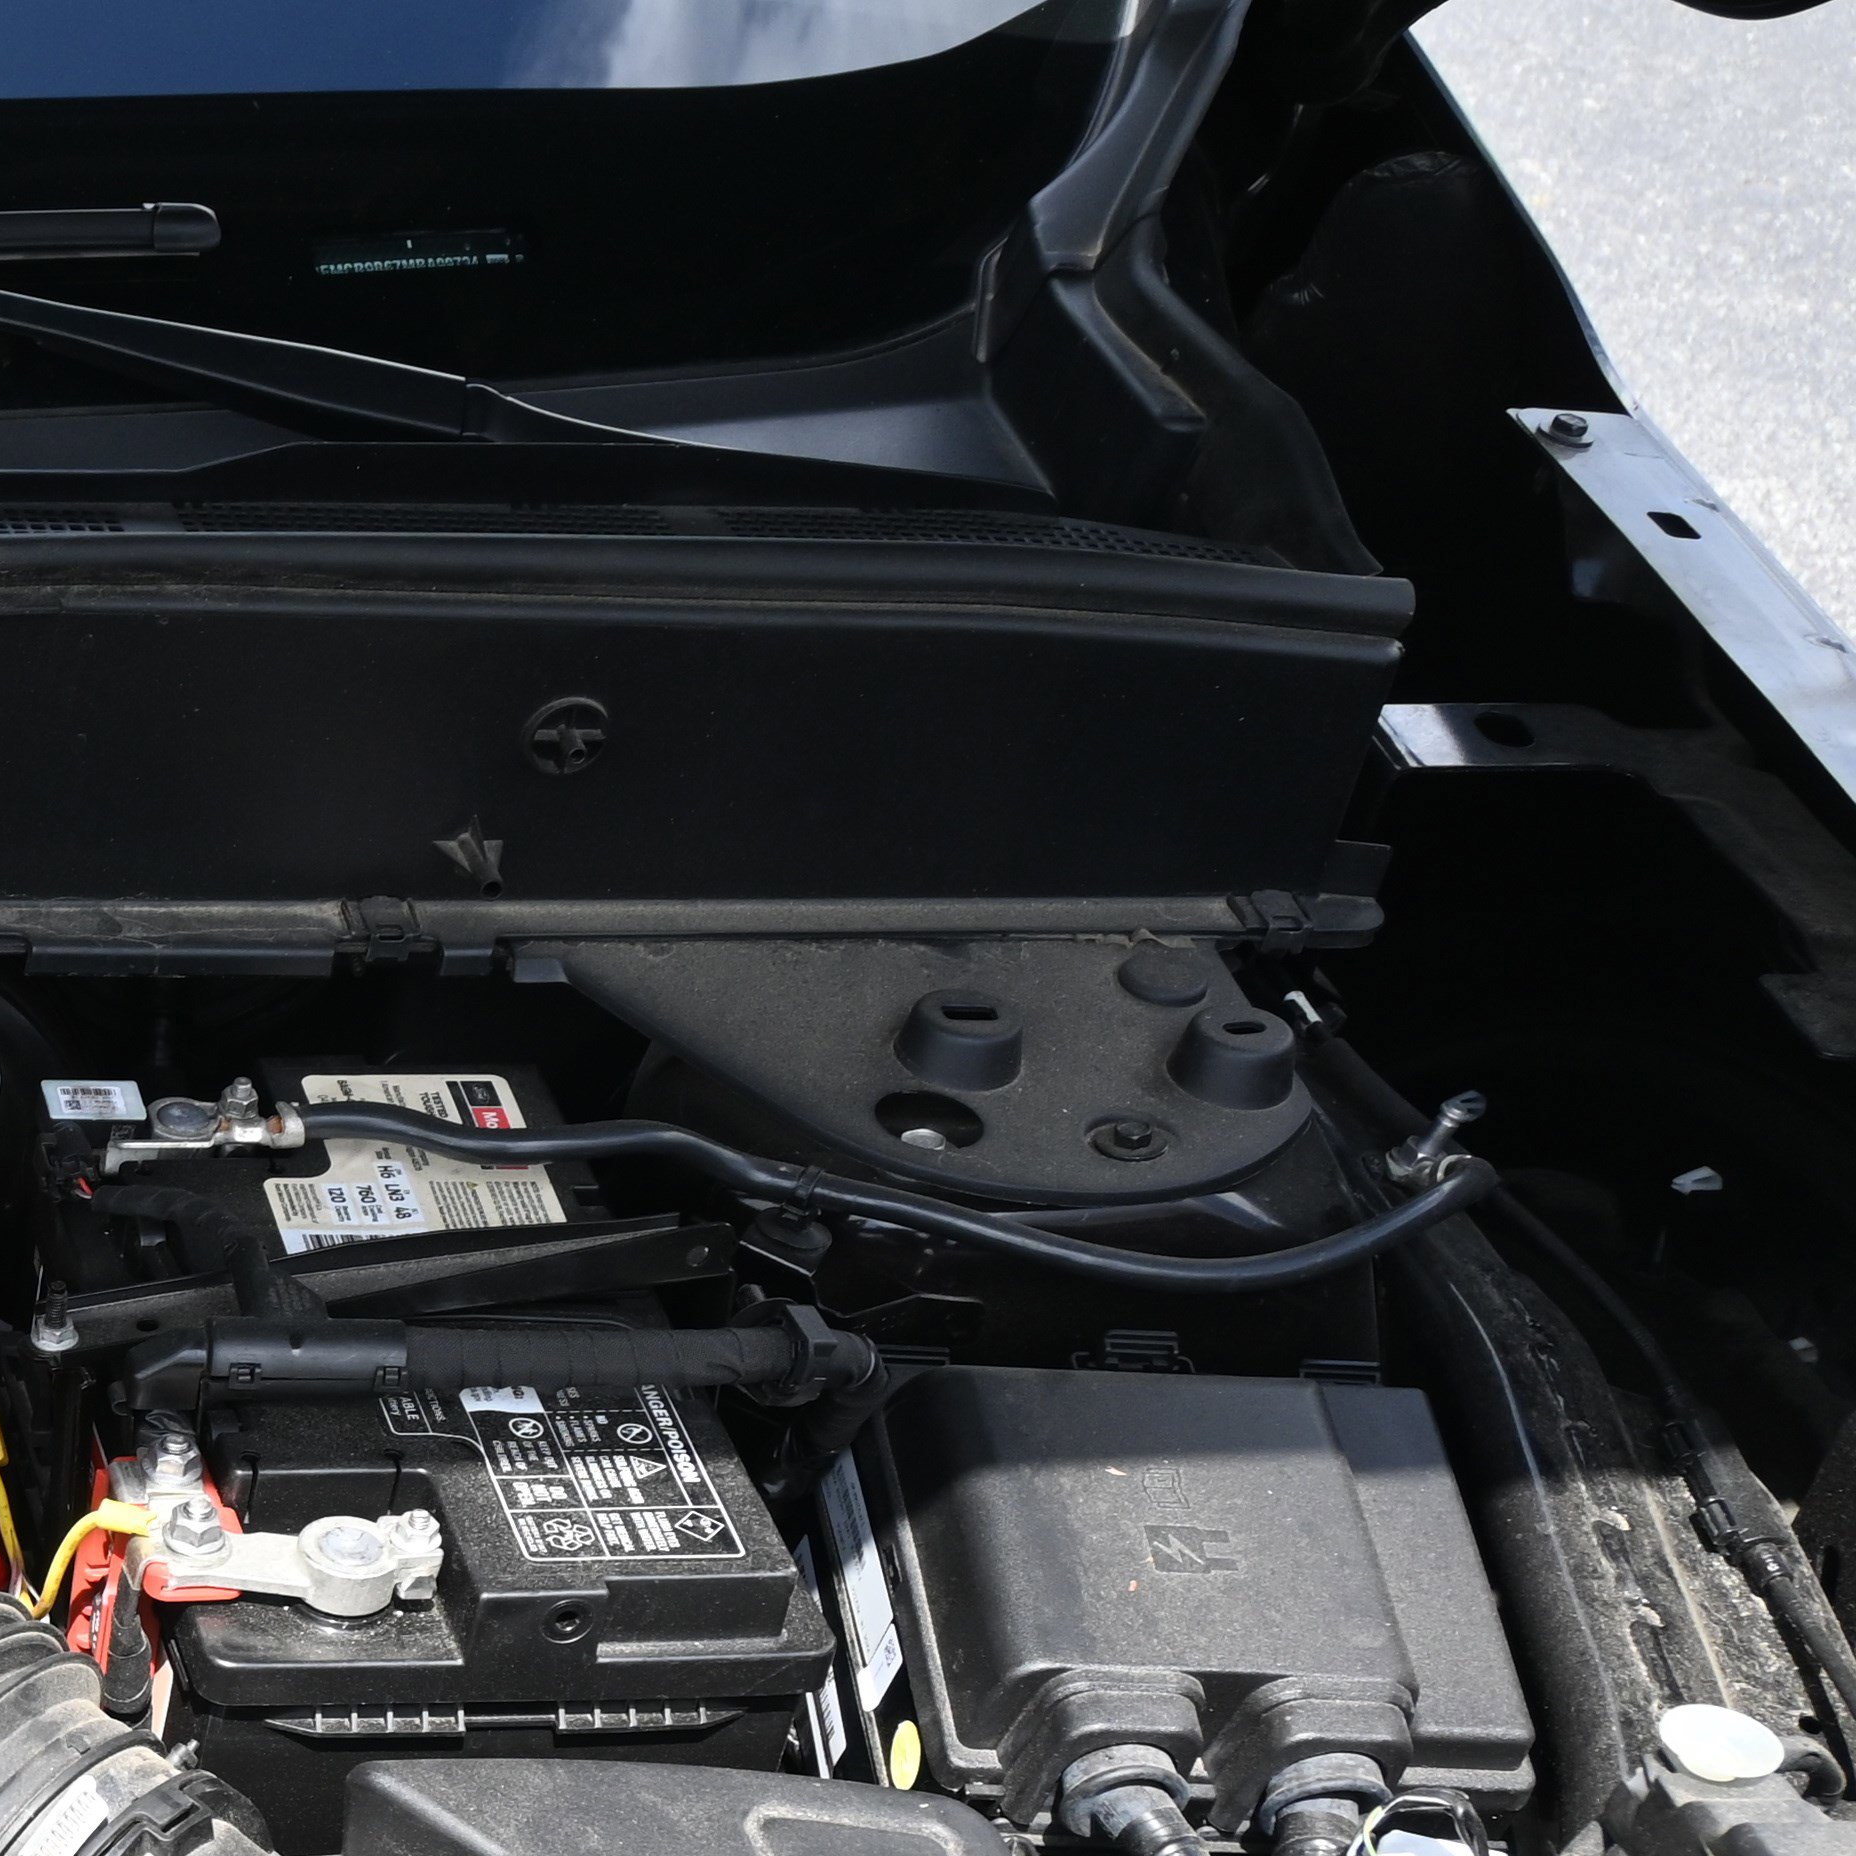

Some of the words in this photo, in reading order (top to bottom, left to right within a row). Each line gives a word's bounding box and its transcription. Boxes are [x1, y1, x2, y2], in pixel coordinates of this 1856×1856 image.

[377, 1165, 396, 1179] H6
[327, 1187, 346, 1203] 120
[356, 1185, 376, 1203] 760
[384, 1184, 405, 1201] LN3
[394, 1207, 412, 1219] 48
[400, 1396, 420, 1421] ABLE
[641, 1384, 701, 1483] ANGER/POISON
[530, 1484, 552, 1502] NOT
